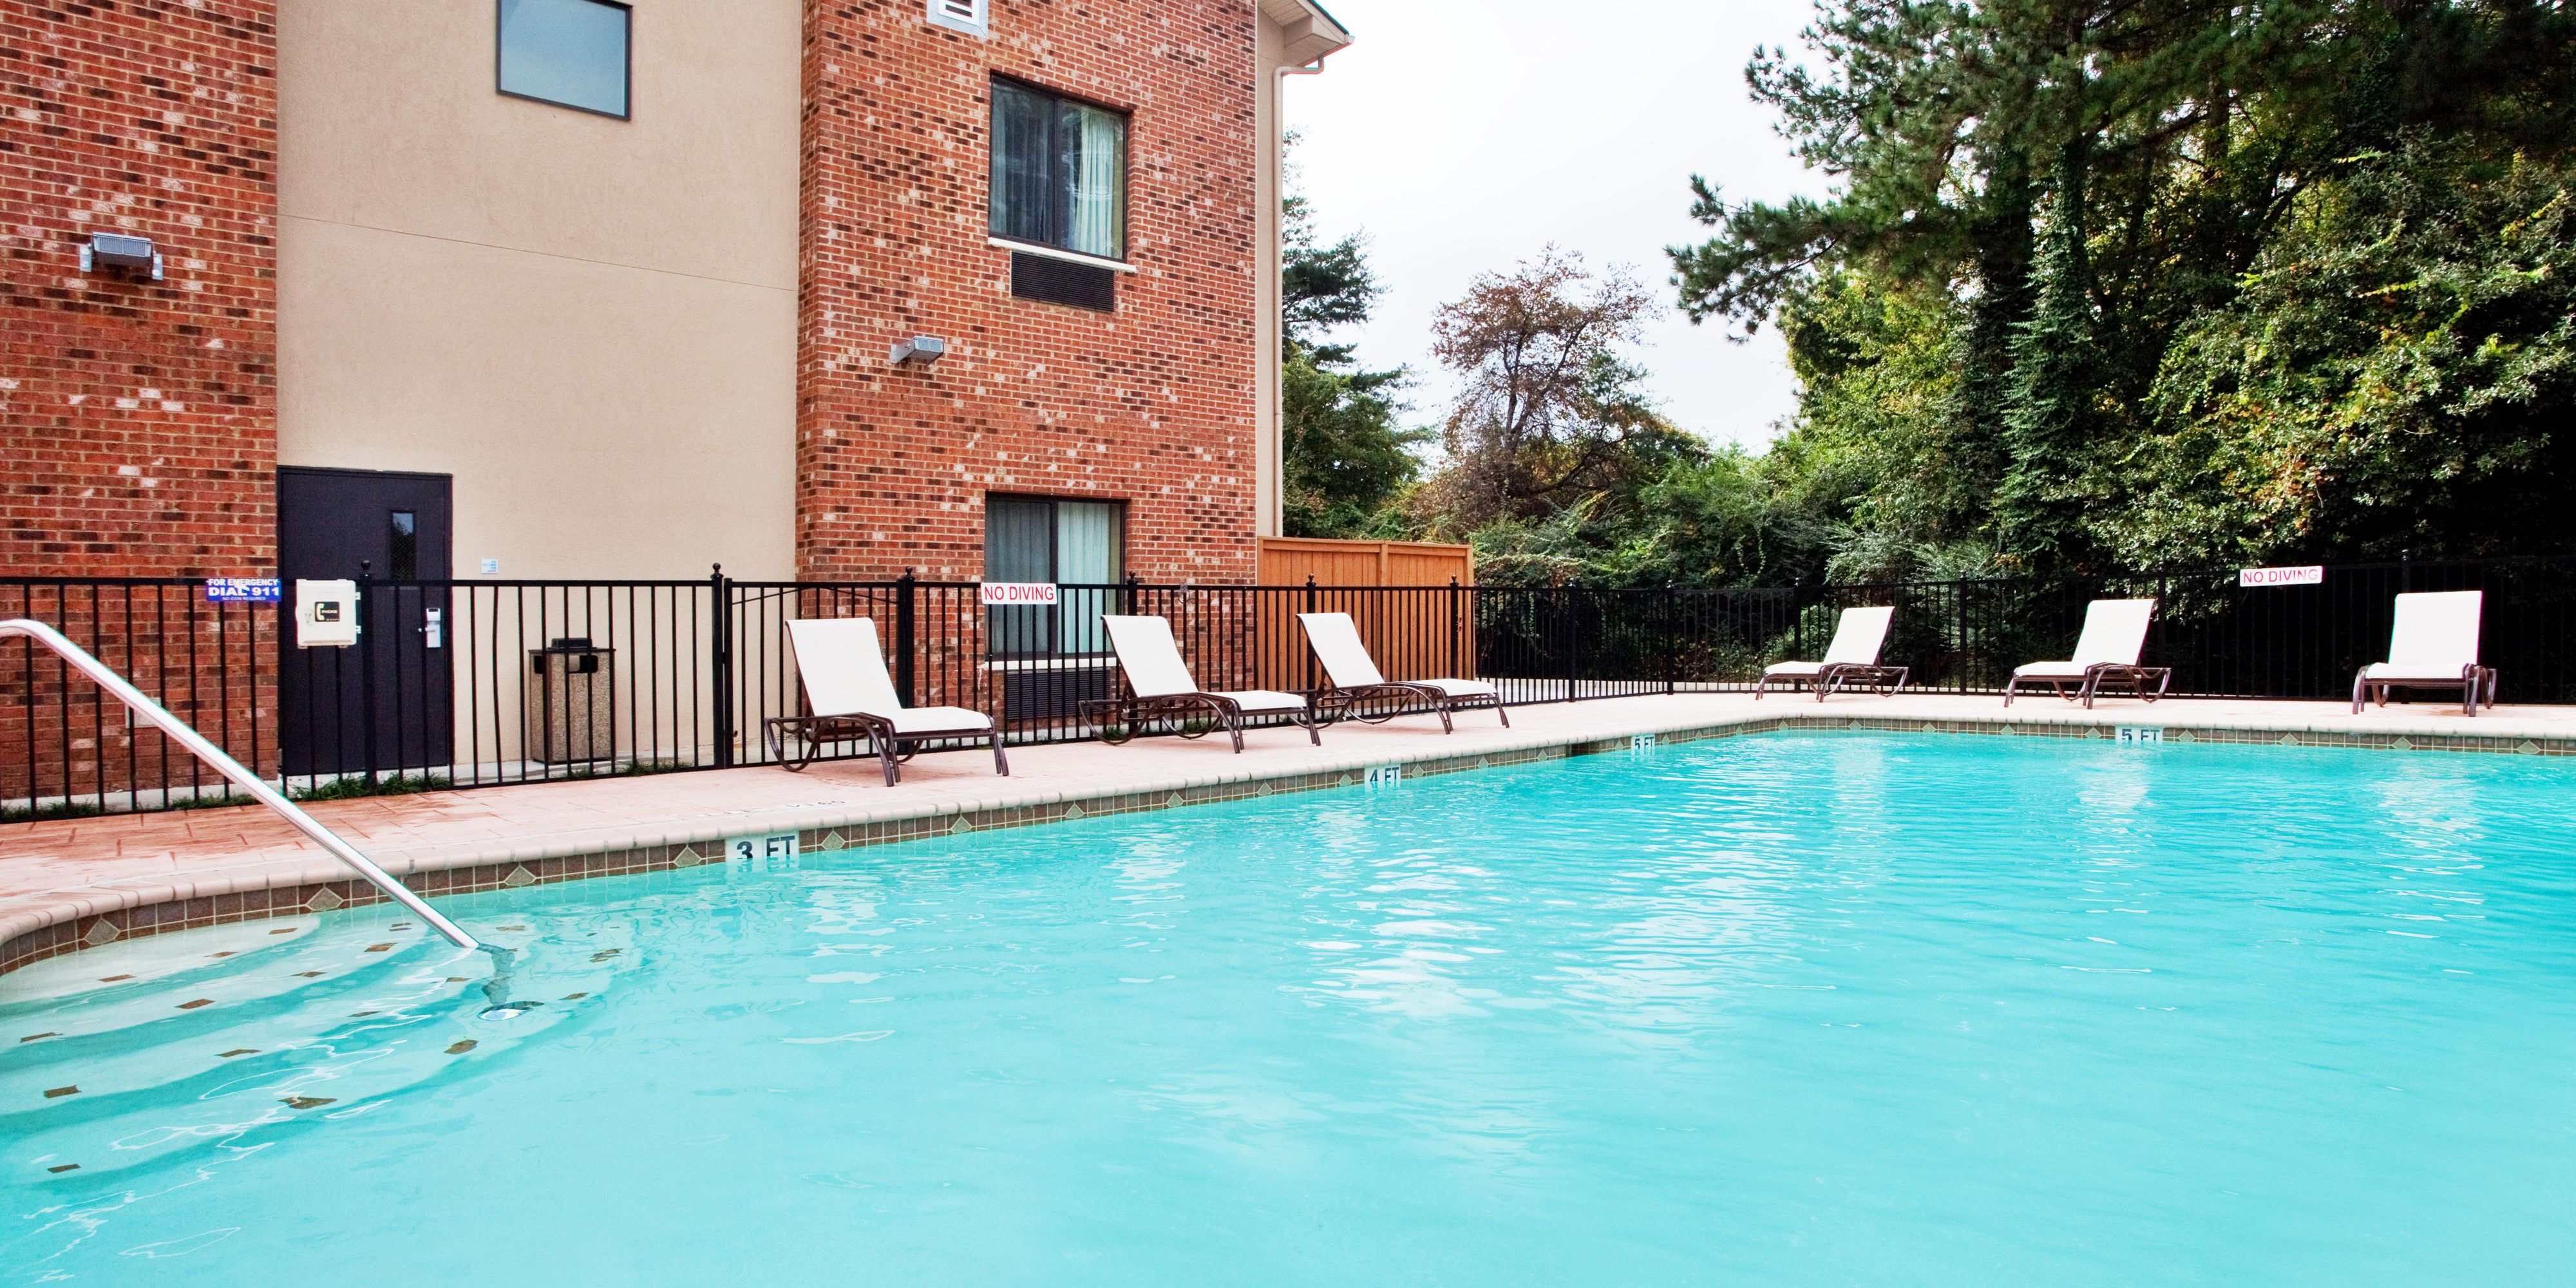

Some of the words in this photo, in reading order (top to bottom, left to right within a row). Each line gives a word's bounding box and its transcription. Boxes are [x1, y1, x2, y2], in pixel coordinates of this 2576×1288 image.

[2243, 571, 2264, 583] NO
[2269, 569, 2318, 583] DIVING
[208, 587, 248, 596] DIAL
[252, 587, 279, 596] 911
[984, 586, 1005, 600] NO
[1009, 586, 1054, 600] DIVING
[2121, 728, 2133, 741] 5
[2141, 729, 2160, 741] FT
[1634, 738, 1640, 749] 5
[1644, 736, 1654, 748] FT
[1370, 769, 1379, 782] 4
[1385, 766, 1399, 781] FT
[737, 841, 753, 859] 3
[766, 835, 795, 857] FT
